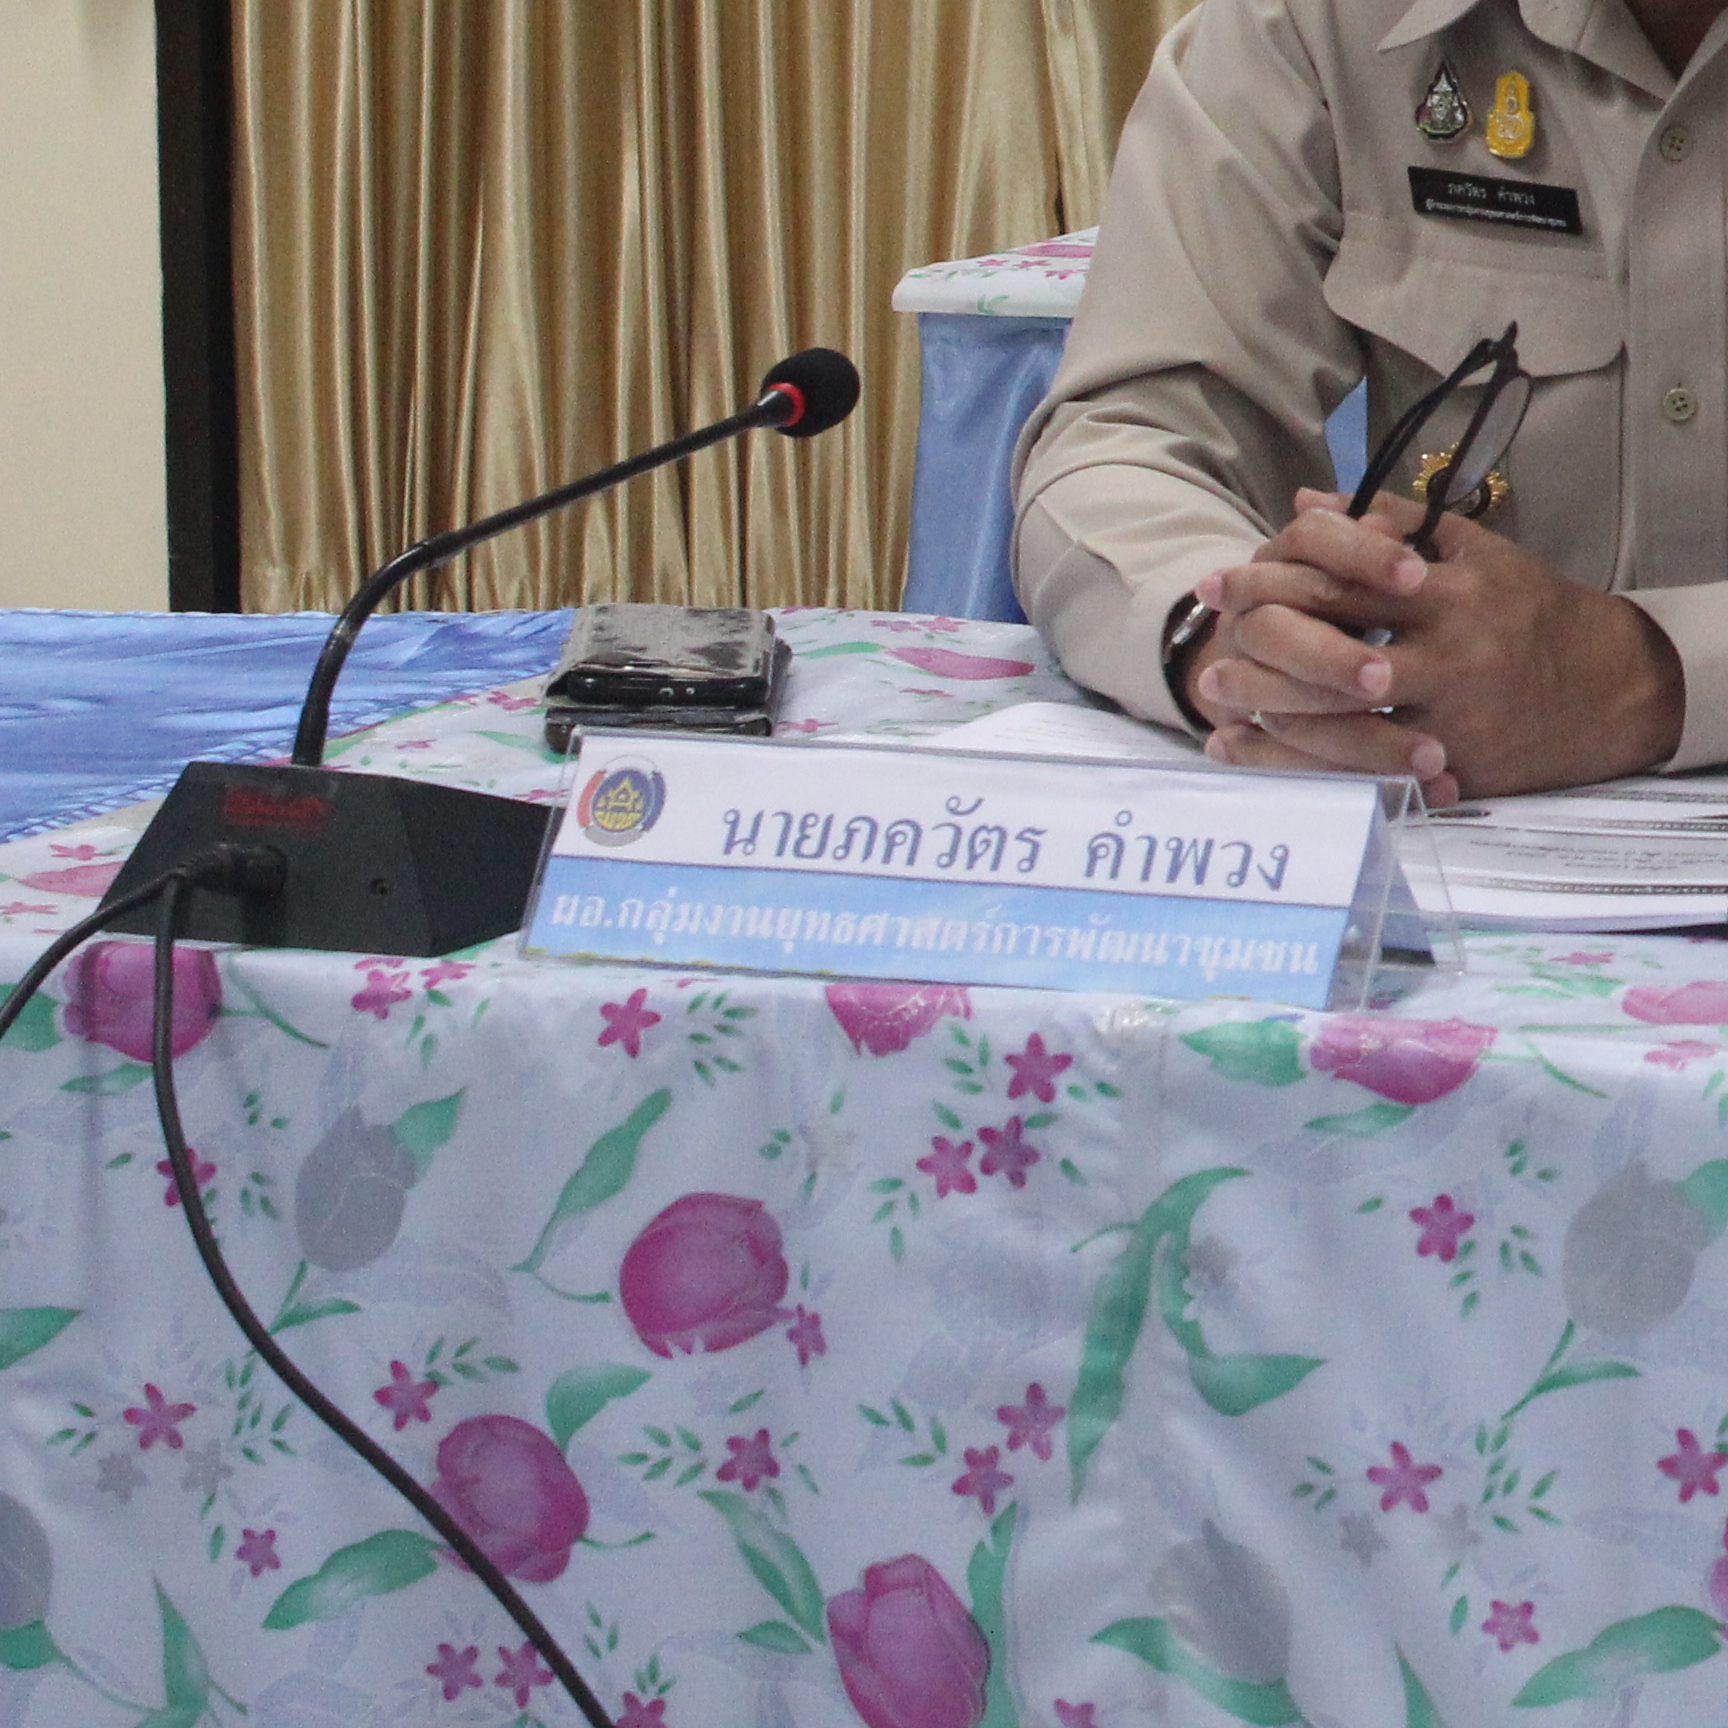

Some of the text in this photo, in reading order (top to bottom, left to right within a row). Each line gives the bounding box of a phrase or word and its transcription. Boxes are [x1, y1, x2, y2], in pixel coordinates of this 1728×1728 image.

[722, 797, 1290, 892] นายภควัตร คำพวง
[550, 886, 1319, 978] ผอ.กลุ่มงานยุทธศาสตร์การพัฒนาชุมชน
